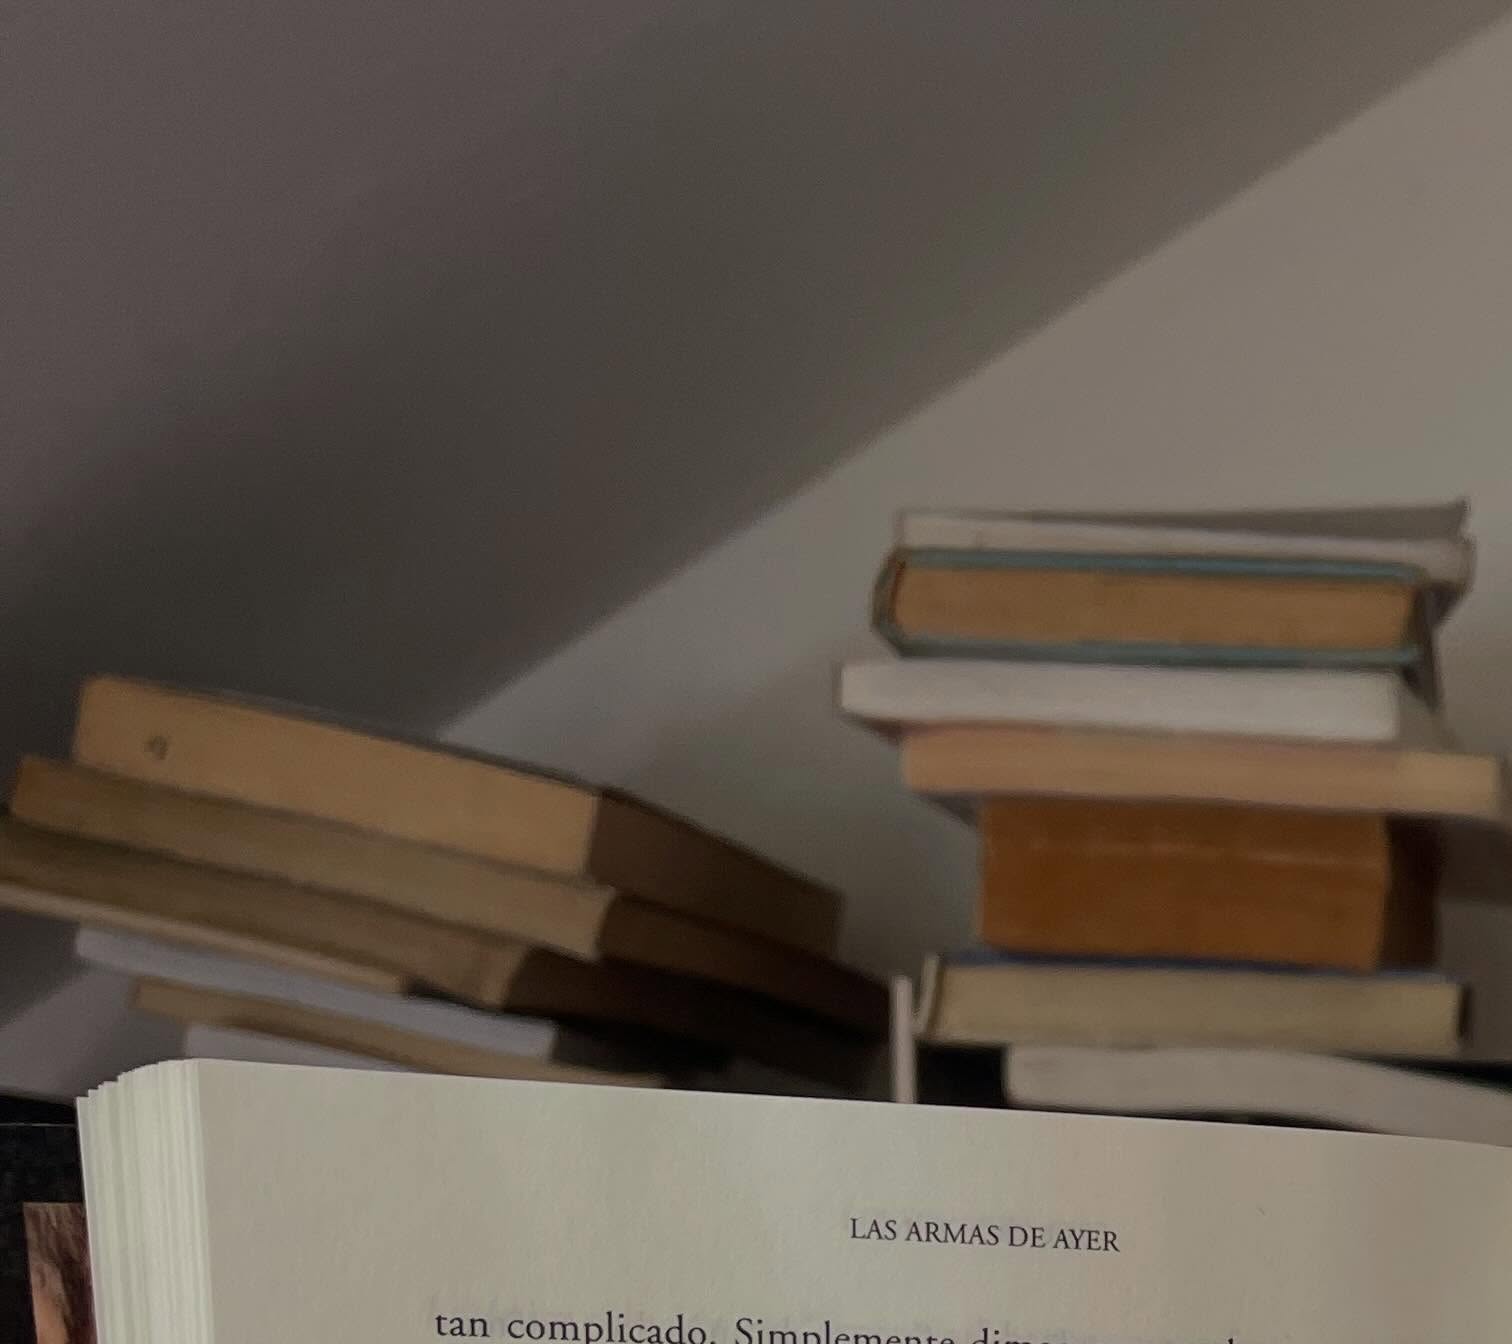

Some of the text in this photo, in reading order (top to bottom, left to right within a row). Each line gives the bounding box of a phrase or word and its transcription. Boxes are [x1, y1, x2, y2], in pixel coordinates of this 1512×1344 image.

[849, 1216, 1122, 1254] LAS ARMAS DE AYER
[433, 1313, 492, 1339] tan
